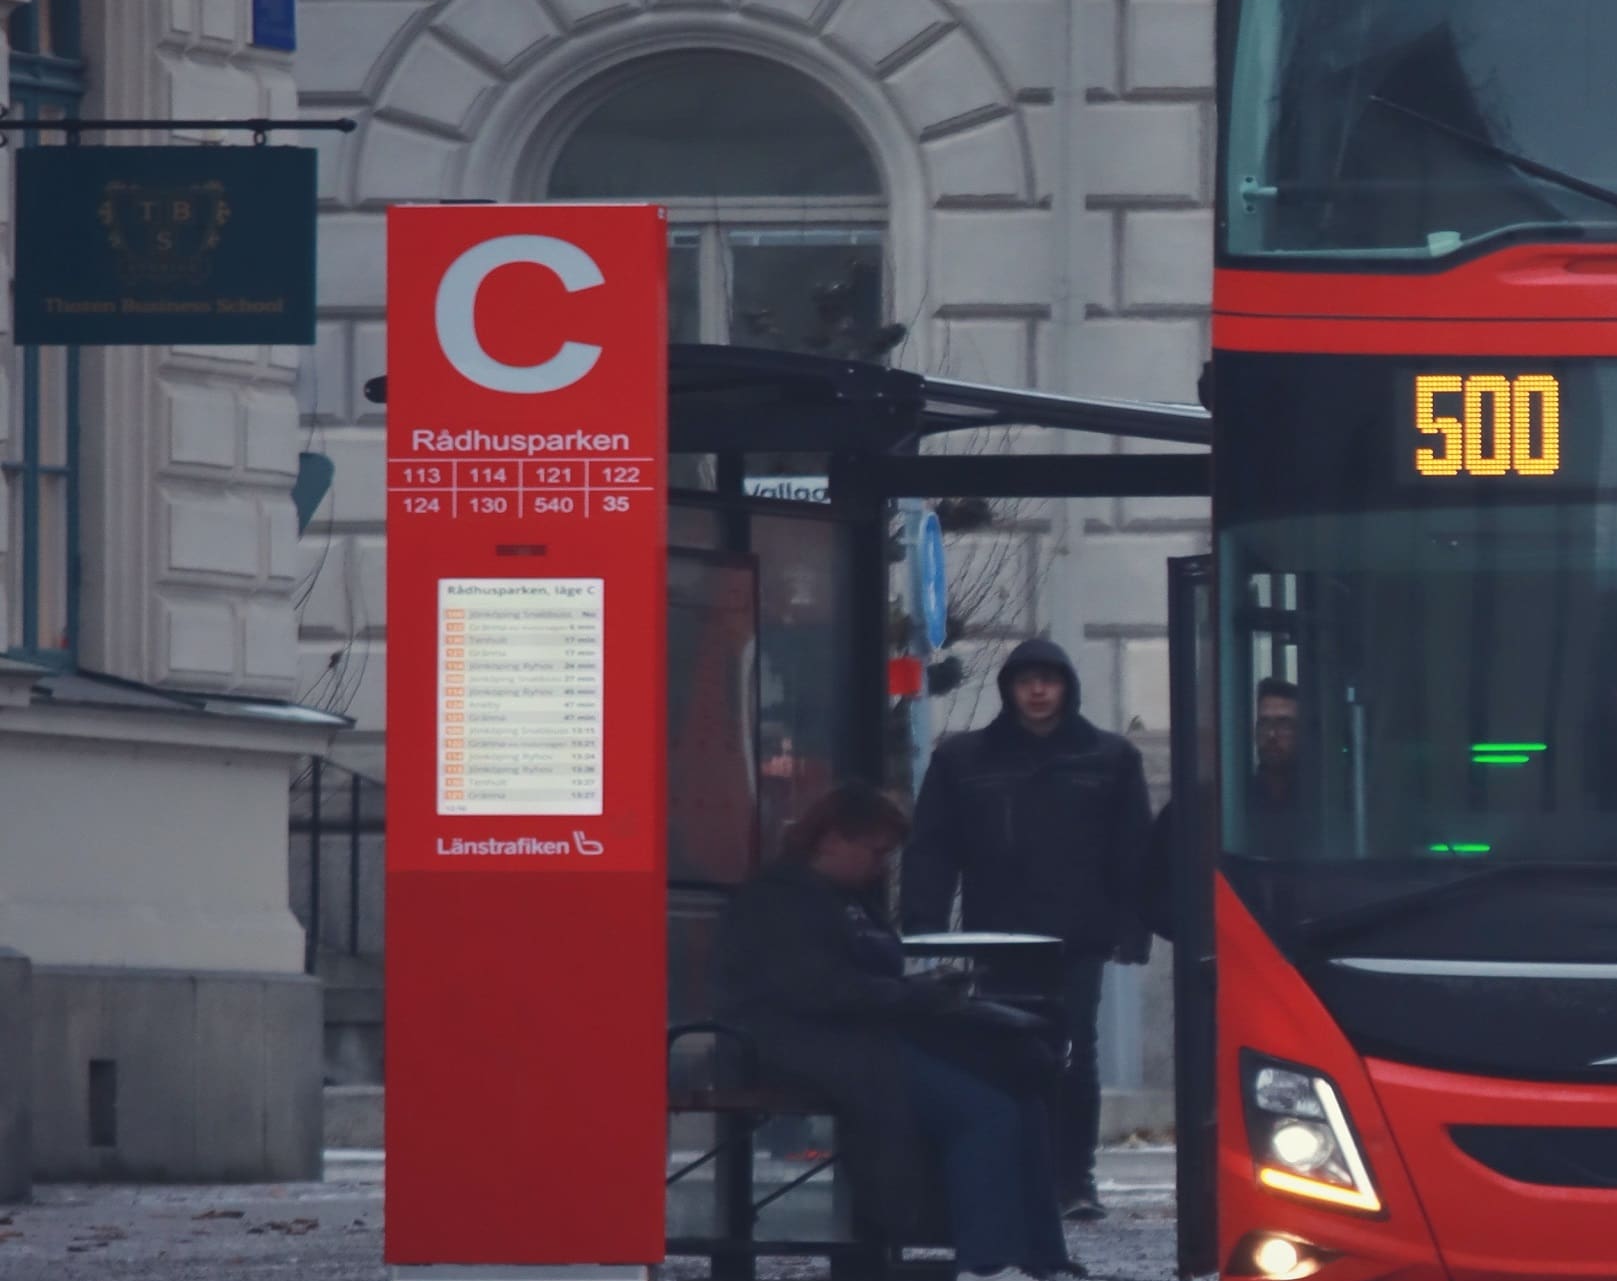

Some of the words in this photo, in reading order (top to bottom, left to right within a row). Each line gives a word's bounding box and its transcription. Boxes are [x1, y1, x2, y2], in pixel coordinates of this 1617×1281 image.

[434, 233, 606, 394] C
[1415, 374, 1560, 476] 500
[411, 428, 630, 456] Rådhusparken
[403, 467, 441, 484] 113
[469, 467, 507, 484] 114
[535, 467, 572, 484] 121
[602, 467, 640, 484] 122
[403, 497, 440, 514] 124
[469, 497, 508, 514] 130
[533, 497, 574, 514] 540
[602, 495, 630, 513] 35
[436, 837, 570, 856] Länstrafiken
